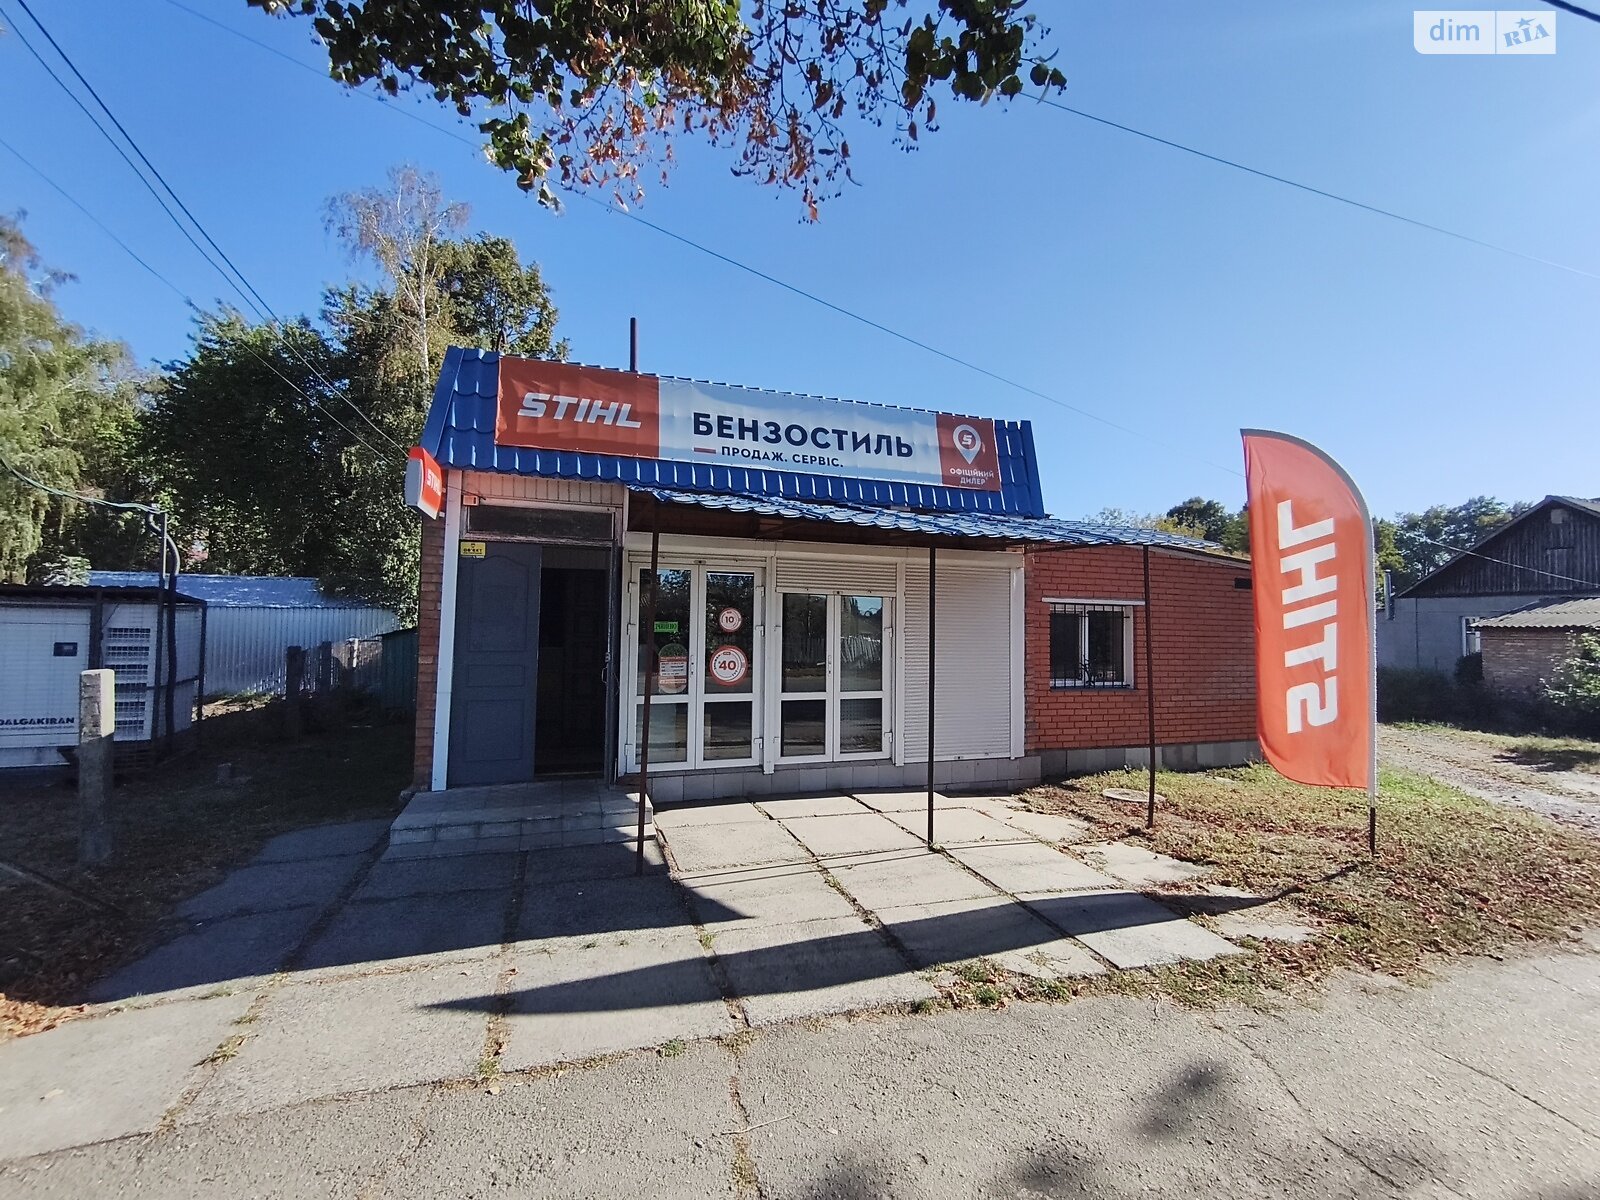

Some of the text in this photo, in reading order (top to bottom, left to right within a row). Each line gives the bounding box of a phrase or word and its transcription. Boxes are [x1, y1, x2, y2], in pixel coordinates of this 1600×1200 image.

[517, 392, 642, 429] STIHL
[693, 412, 914, 458] БЕНЗОСТИЛЬ
[721, 446, 844, 468] ПРОДАЖ. СЕРВІС.
[949, 467, 995, 478] ОФІЦІЙНИЙ
[960, 476, 986, 485] ДИЛЕР
[725, 616, 735, 624] 10
[718, 660, 737, 671] 40
